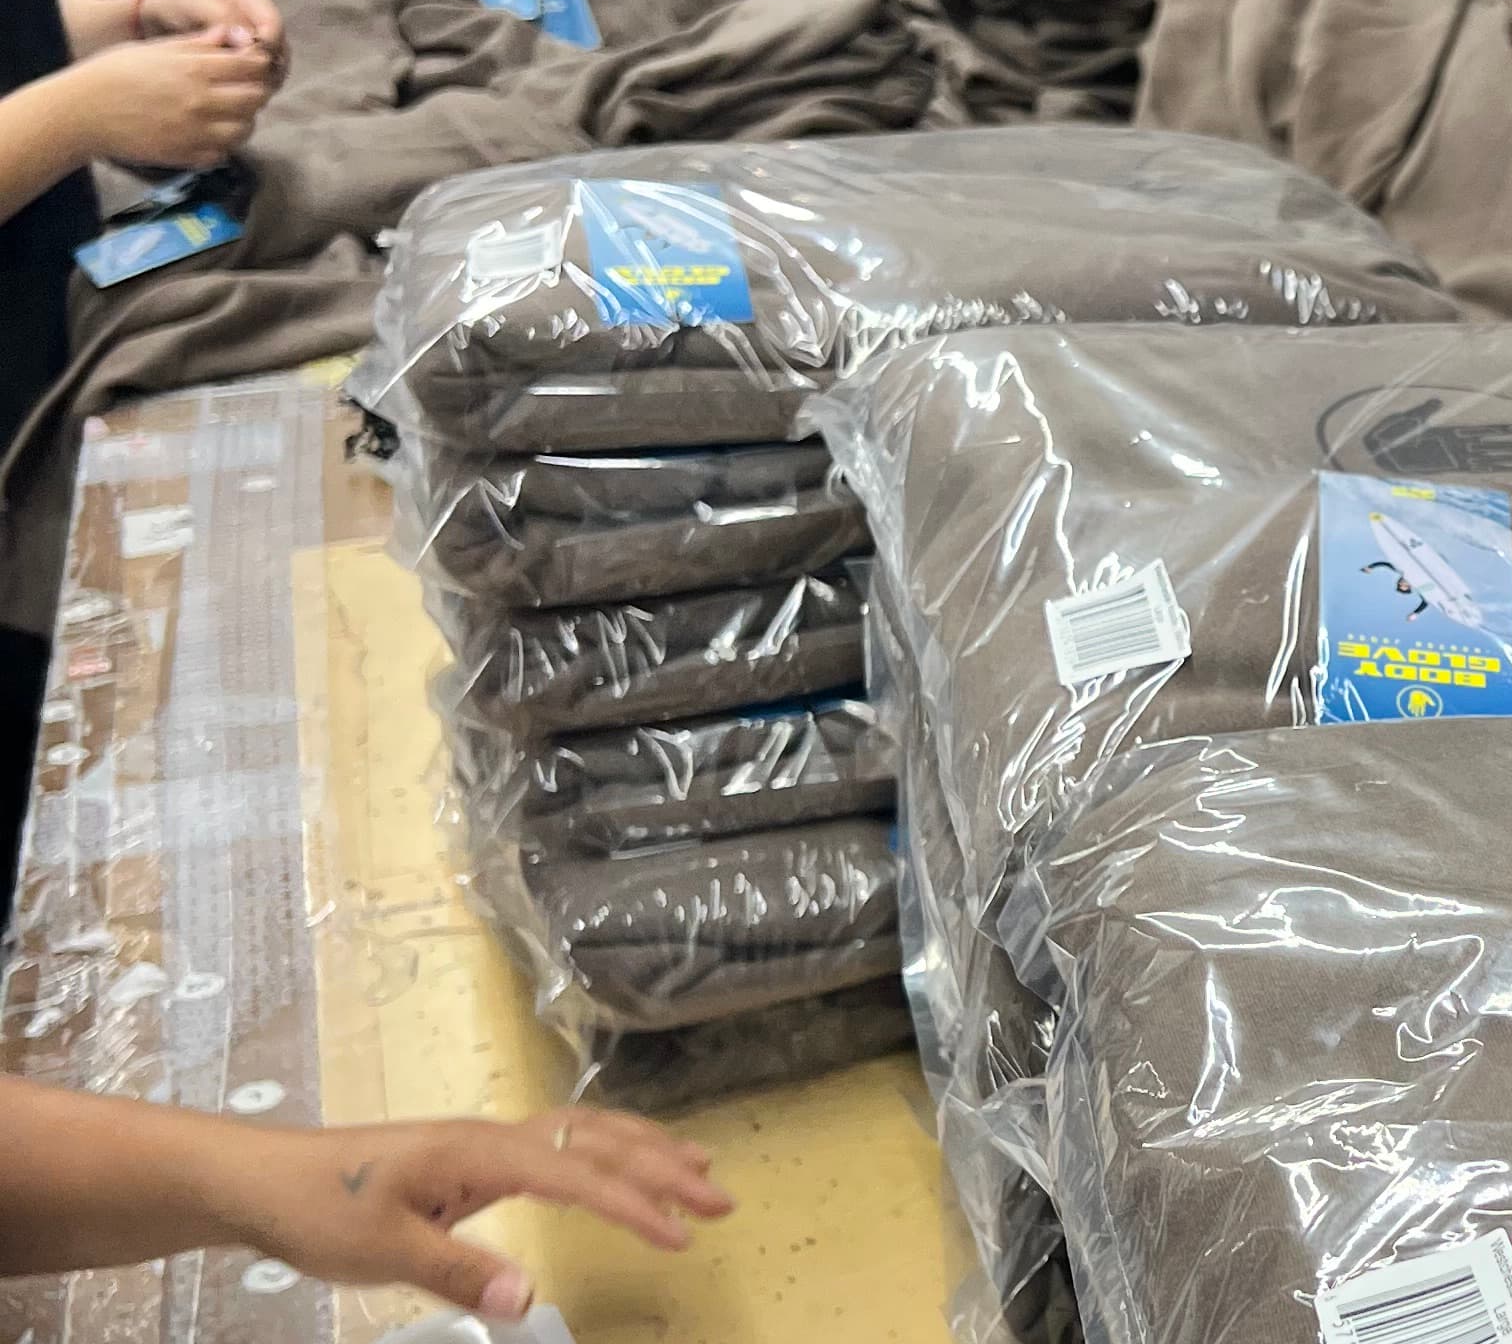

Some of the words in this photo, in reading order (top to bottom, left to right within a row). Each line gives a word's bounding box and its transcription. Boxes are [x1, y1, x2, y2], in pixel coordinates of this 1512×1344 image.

[1337, 642, 1501, 673] GLOVE
[1354, 661, 1487, 688] BODY
[1492, 1303, 1512, 1336] Large
